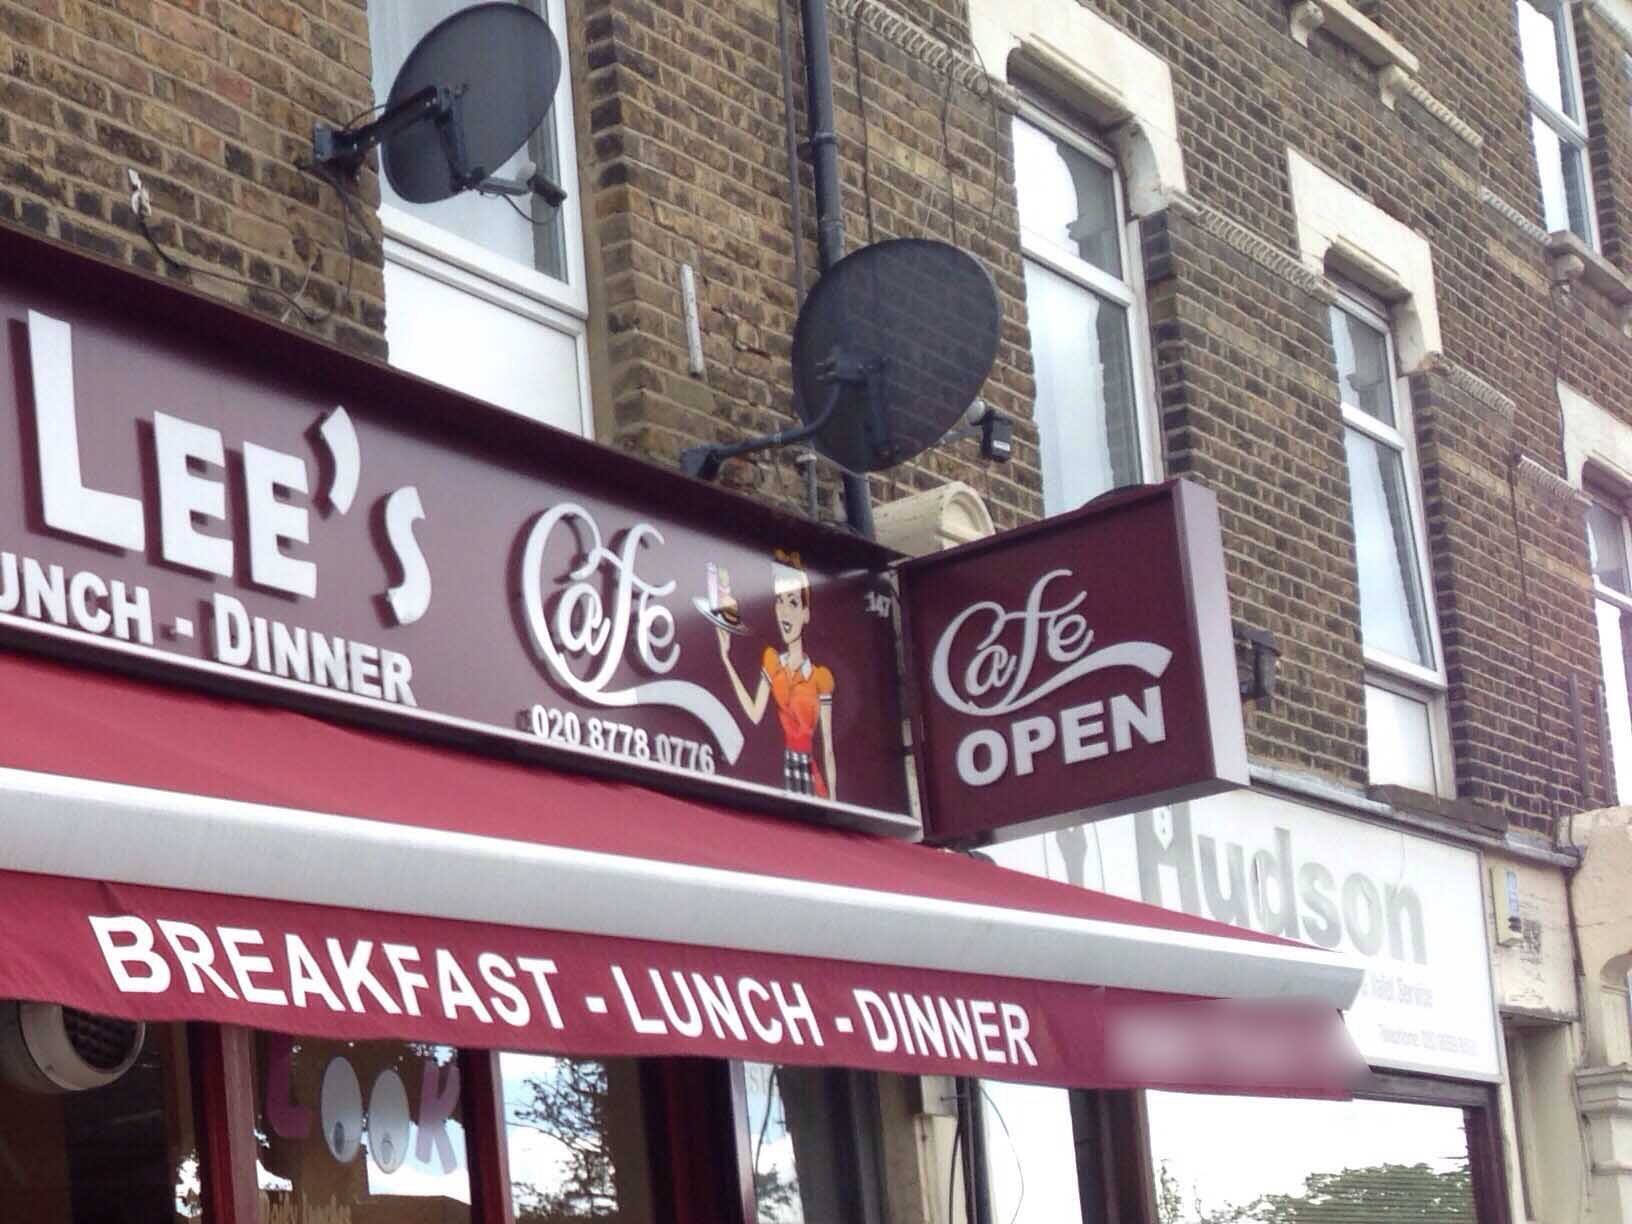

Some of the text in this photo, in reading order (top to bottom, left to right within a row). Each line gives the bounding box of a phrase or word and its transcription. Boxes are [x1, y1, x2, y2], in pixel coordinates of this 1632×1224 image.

[28, 309, 433, 625] LEE'S
[212, 592, 418, 707] DINNER
[530, 703, 715, 774] 020 8778 0776
[956, 686, 1167, 787] OPEN
[1134, 798, 1429, 967] Hudson
[87, 913, 565, 1032] BREAKFAST
[611, 963, 826, 1049] LUNCH
[853, 987, 1039, 1069] DINNER
